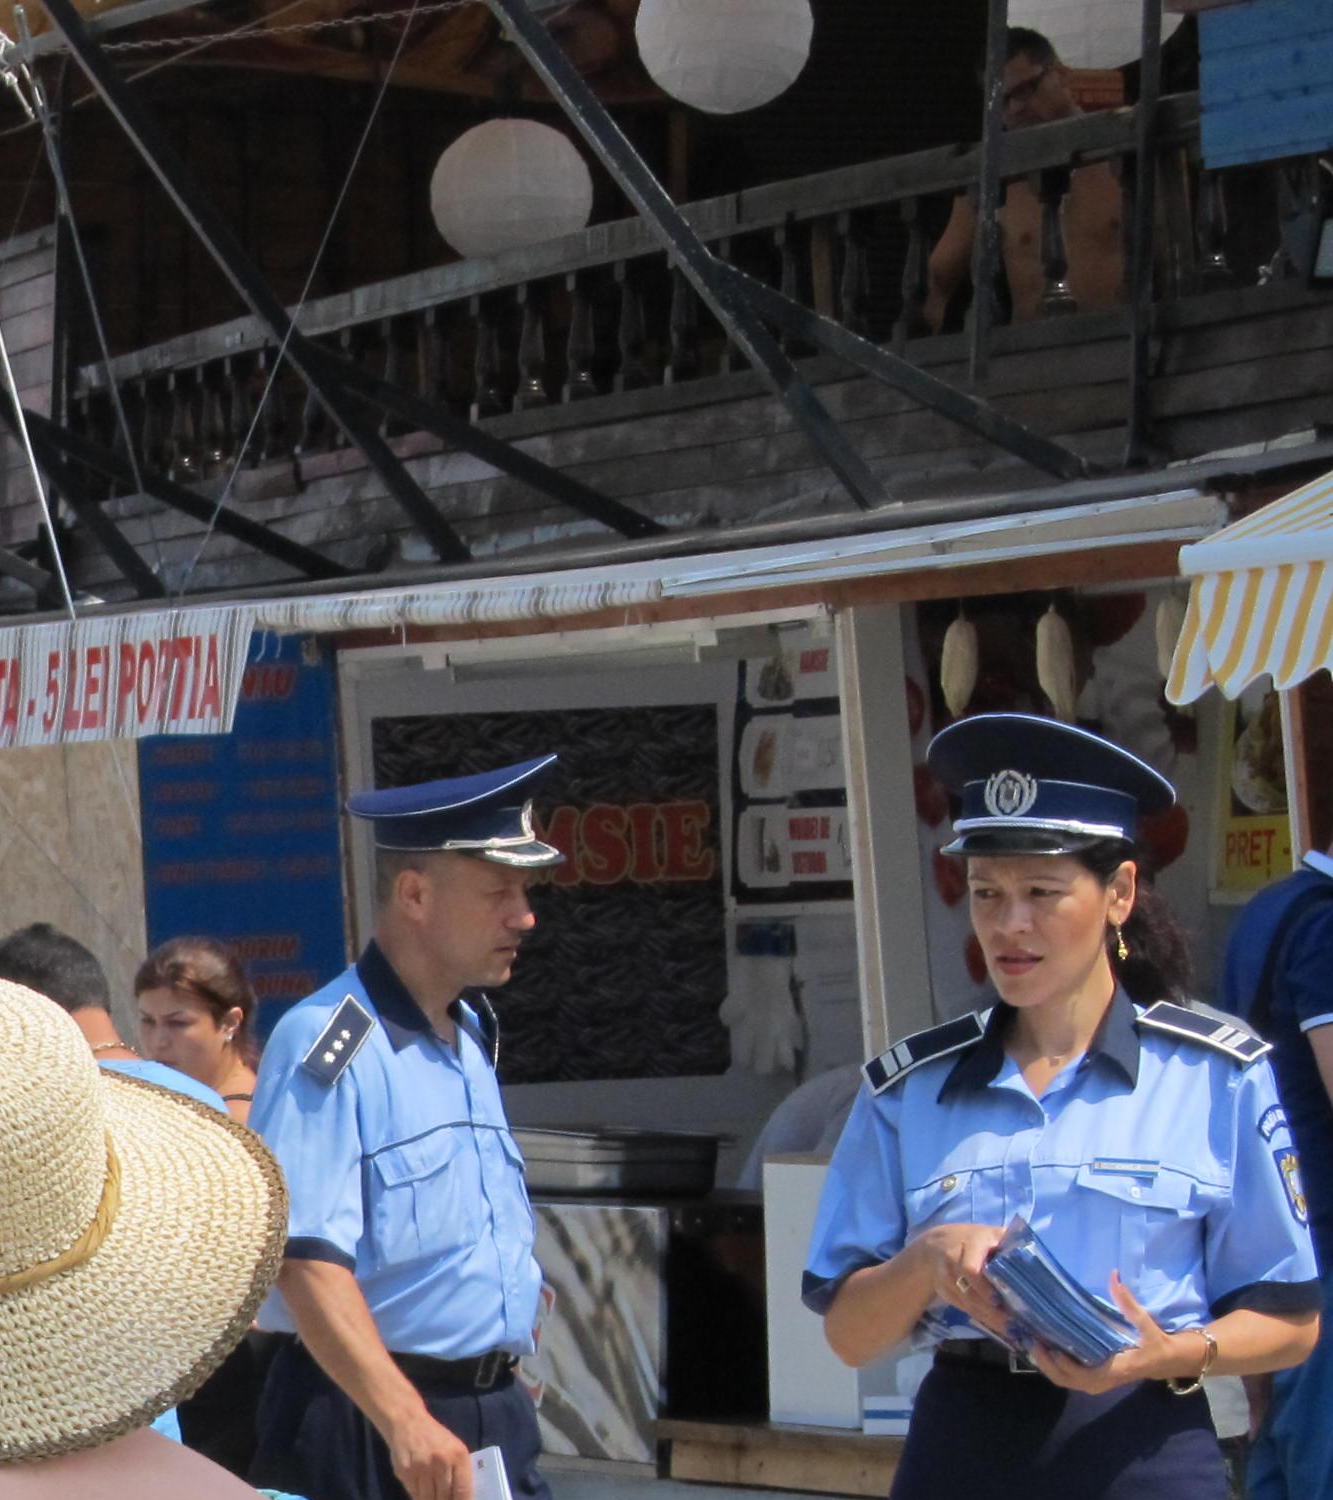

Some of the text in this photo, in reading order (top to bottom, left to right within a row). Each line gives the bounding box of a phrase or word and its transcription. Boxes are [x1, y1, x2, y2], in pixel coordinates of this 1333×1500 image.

[43, 650, 61, 735] 5
[64, 645, 110, 731] LEI
[531, 801, 715, 887] MSIE
